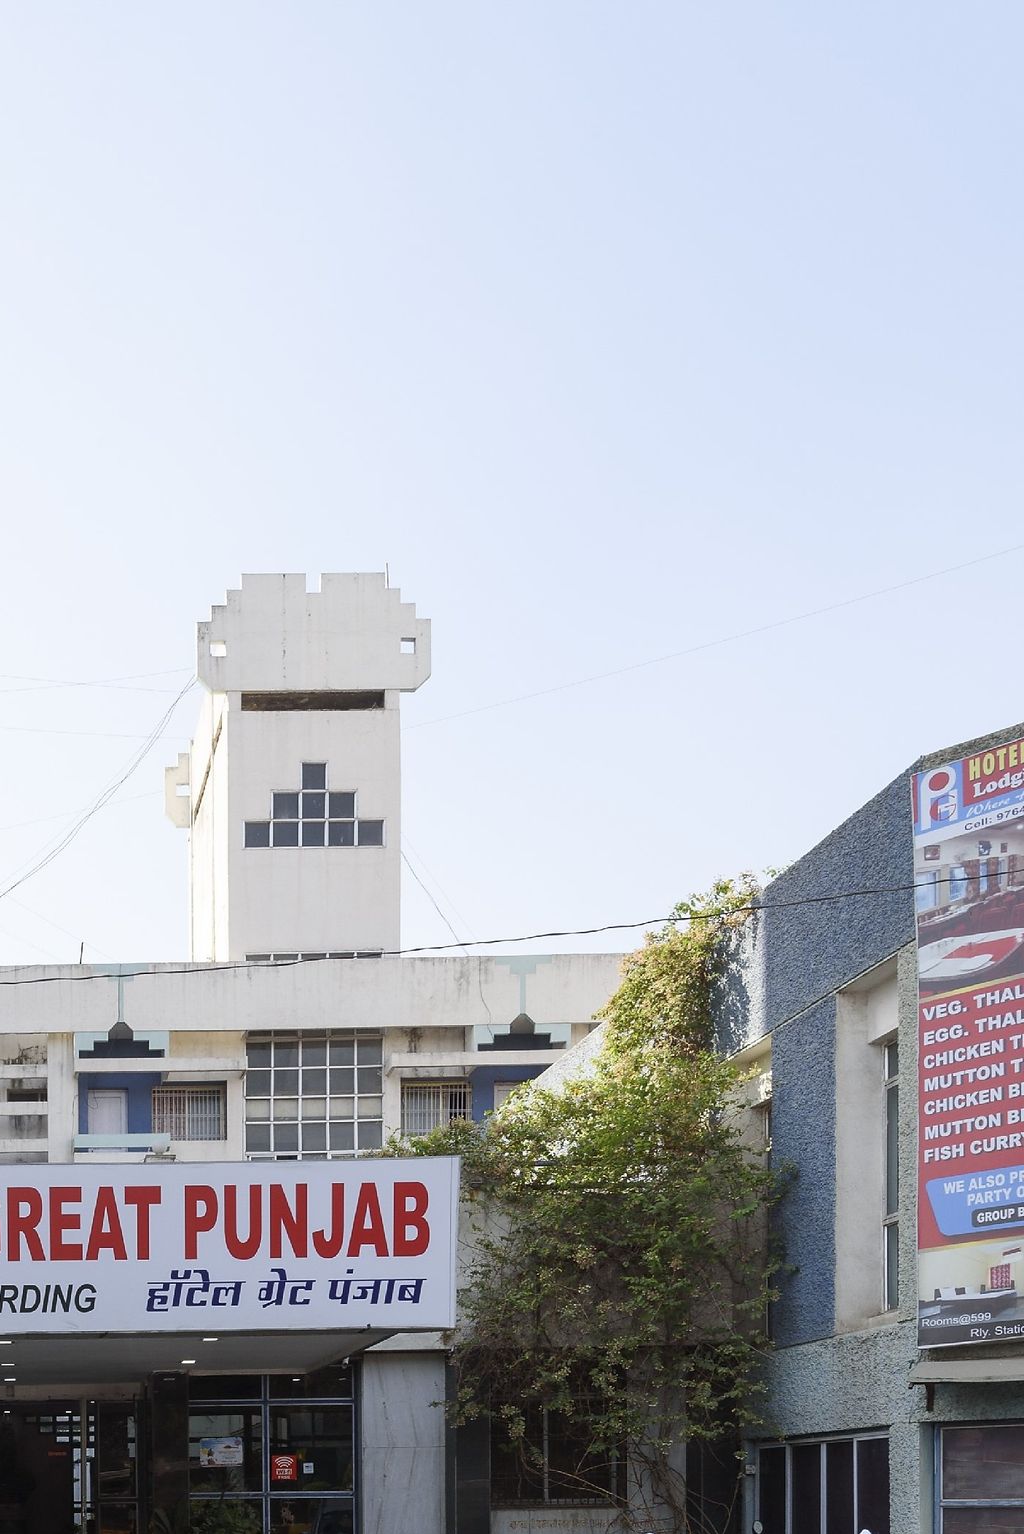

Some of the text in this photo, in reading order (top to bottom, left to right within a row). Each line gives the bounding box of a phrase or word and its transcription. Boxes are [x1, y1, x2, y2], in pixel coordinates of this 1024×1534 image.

[973, 769, 1024, 798] Lodg
[966, 798, 1010, 818] Where
[964, 817, 993, 831] Cell:
[922, 1000, 967, 1021] VEG.
[923, 1024, 969, 1046] EGG.
[923, 1033, 1024, 1069] CHICKEN T
[924, 1062, 1005, 1092] MUTTON
[923, 1086, 1003, 1115] CHICKEN
[924, 1112, 1001, 1140] MUTTON
[923, 1143, 964, 1163] FISH
[943, 1180, 965, 1195] WE
[967, 1173, 1006, 1191] ALSO
[966, 1187, 1012, 1206] PARTY
[184, 1181, 430, 1260] PUNJAB
[976, 1208, 1015, 1223] GROUP
[258, 1268, 316, 1308] ग्रेट
[328, 1268, 427, 1304] पंजाब
[921, 1312, 992, 1327] Rooms@599
[970, 1327, 991, 1339] Rly.
